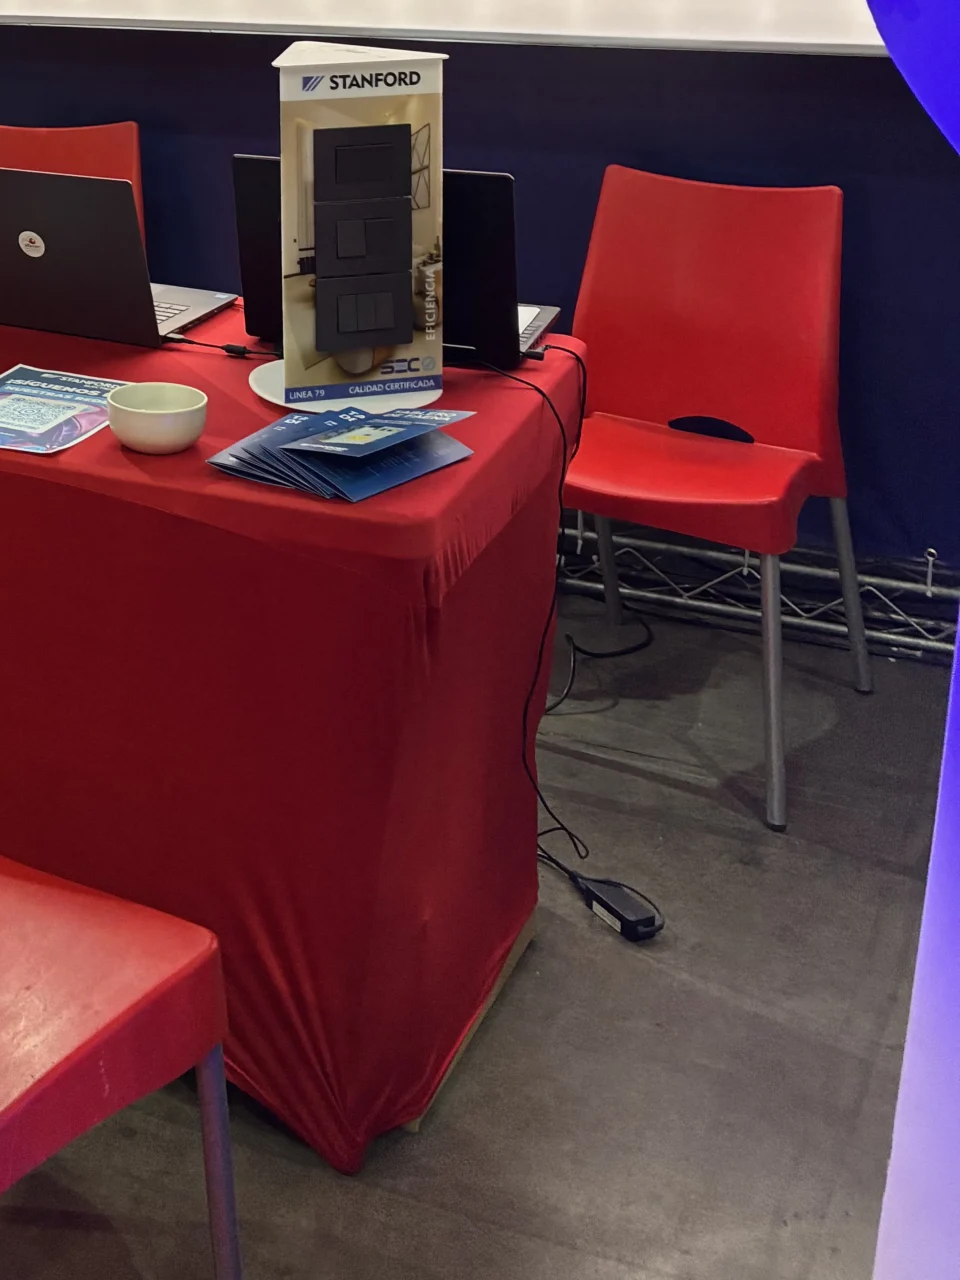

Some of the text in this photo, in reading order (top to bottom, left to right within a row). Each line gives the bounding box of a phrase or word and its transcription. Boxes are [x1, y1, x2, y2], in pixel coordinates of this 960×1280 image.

[329, 71, 421, 90] STANFORD
[425, 270, 436, 340] EFICIENCIA
[380, 357, 420, 374] SEC
[290, 379, 435, 399] LINEA 79 CALIDAD CERTIFICADA
